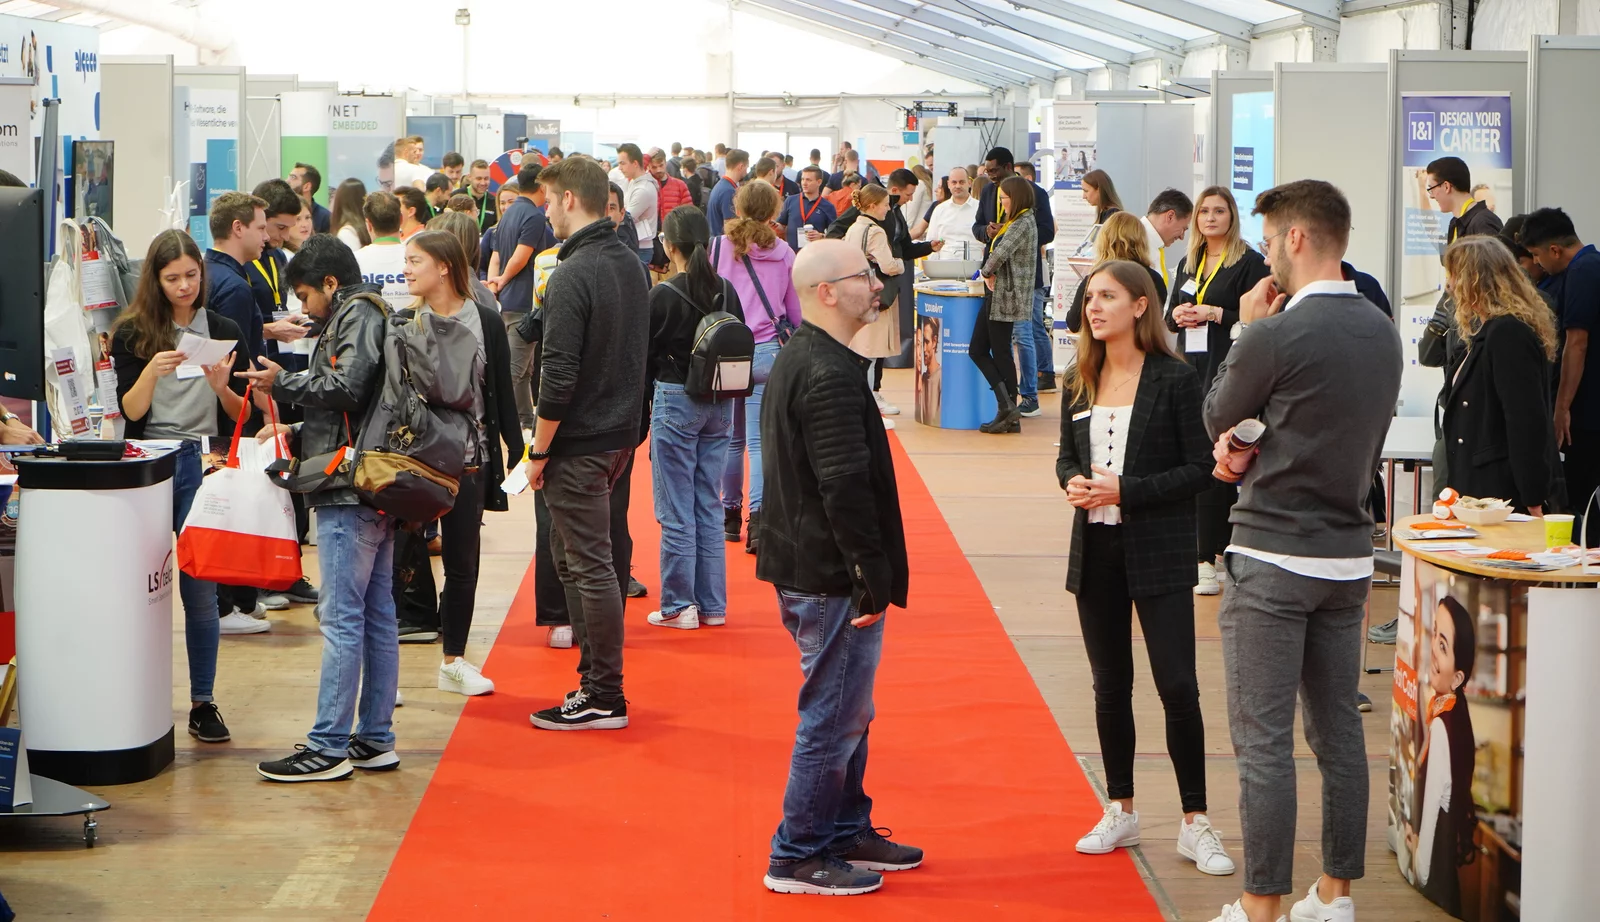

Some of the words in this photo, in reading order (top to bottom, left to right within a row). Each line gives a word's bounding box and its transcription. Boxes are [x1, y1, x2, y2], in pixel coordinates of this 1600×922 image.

[332, 120, 378, 131] EMBEDDED
[1440, 111, 1473, 127] DESIGN
[1475, 111, 1501, 127] YOUR
[1411, 121, 1432, 141] 1&1
[1440, 128, 1501, 153] CAREER
[362, 273, 405, 289] algec
[8, 505, 19, 515] 3G
[148, 571, 159, 594] LS
